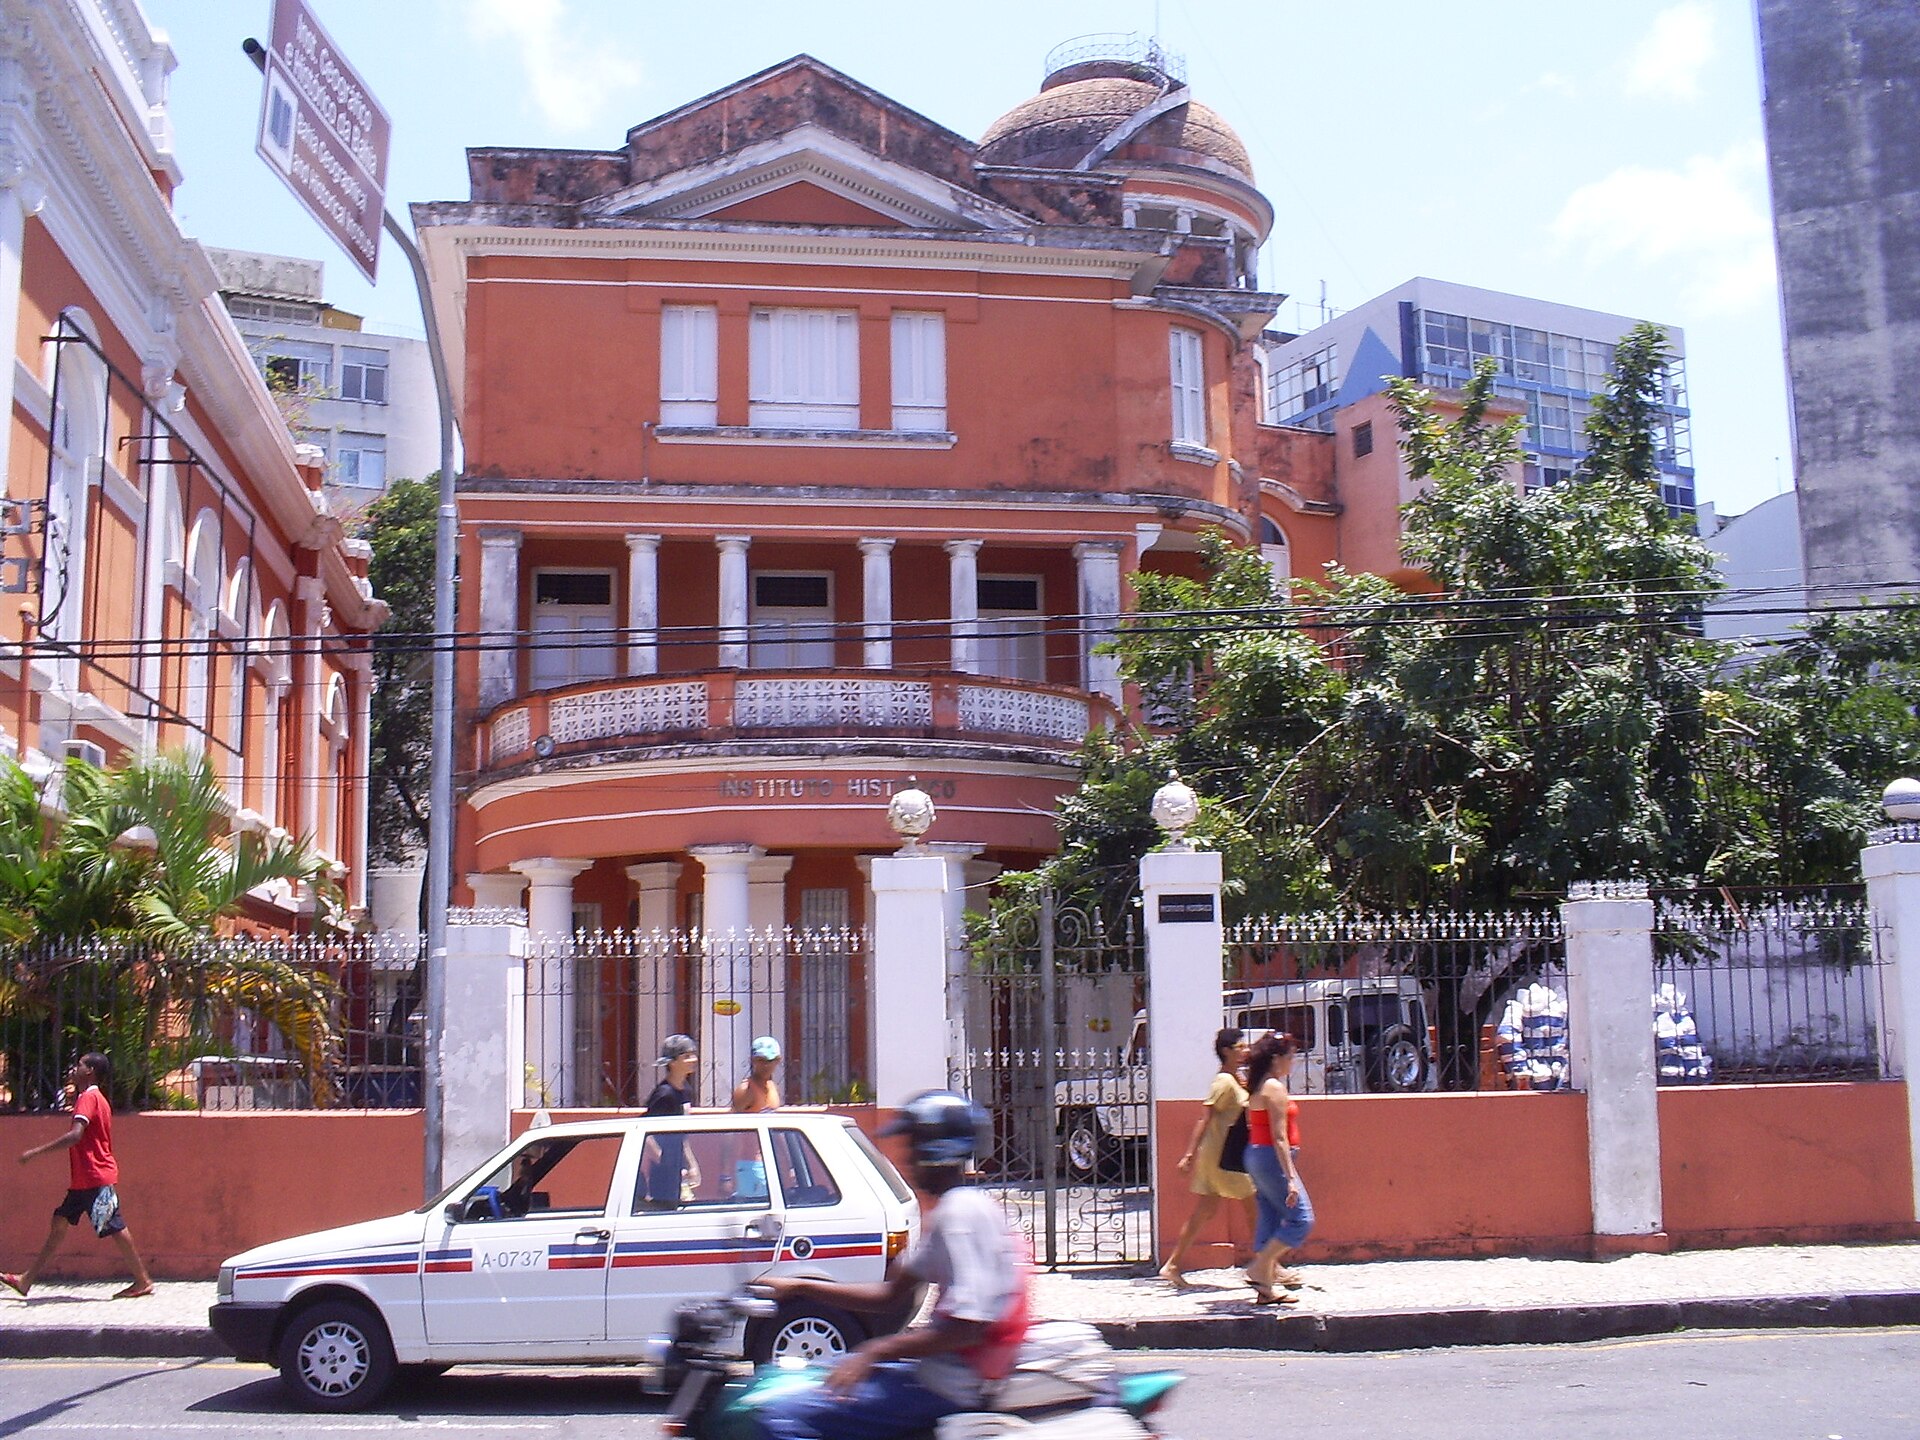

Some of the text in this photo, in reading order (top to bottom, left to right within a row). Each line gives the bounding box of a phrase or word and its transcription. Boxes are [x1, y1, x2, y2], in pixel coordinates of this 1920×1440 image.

[284, 41, 295, 67] e
[336, 111, 352, 142] da
[351, 123, 378, 177] Bahia
[719, 778, 957, 799] INSTITUTO HISTCO
[481, 1250, 543, 1268] A-0737
